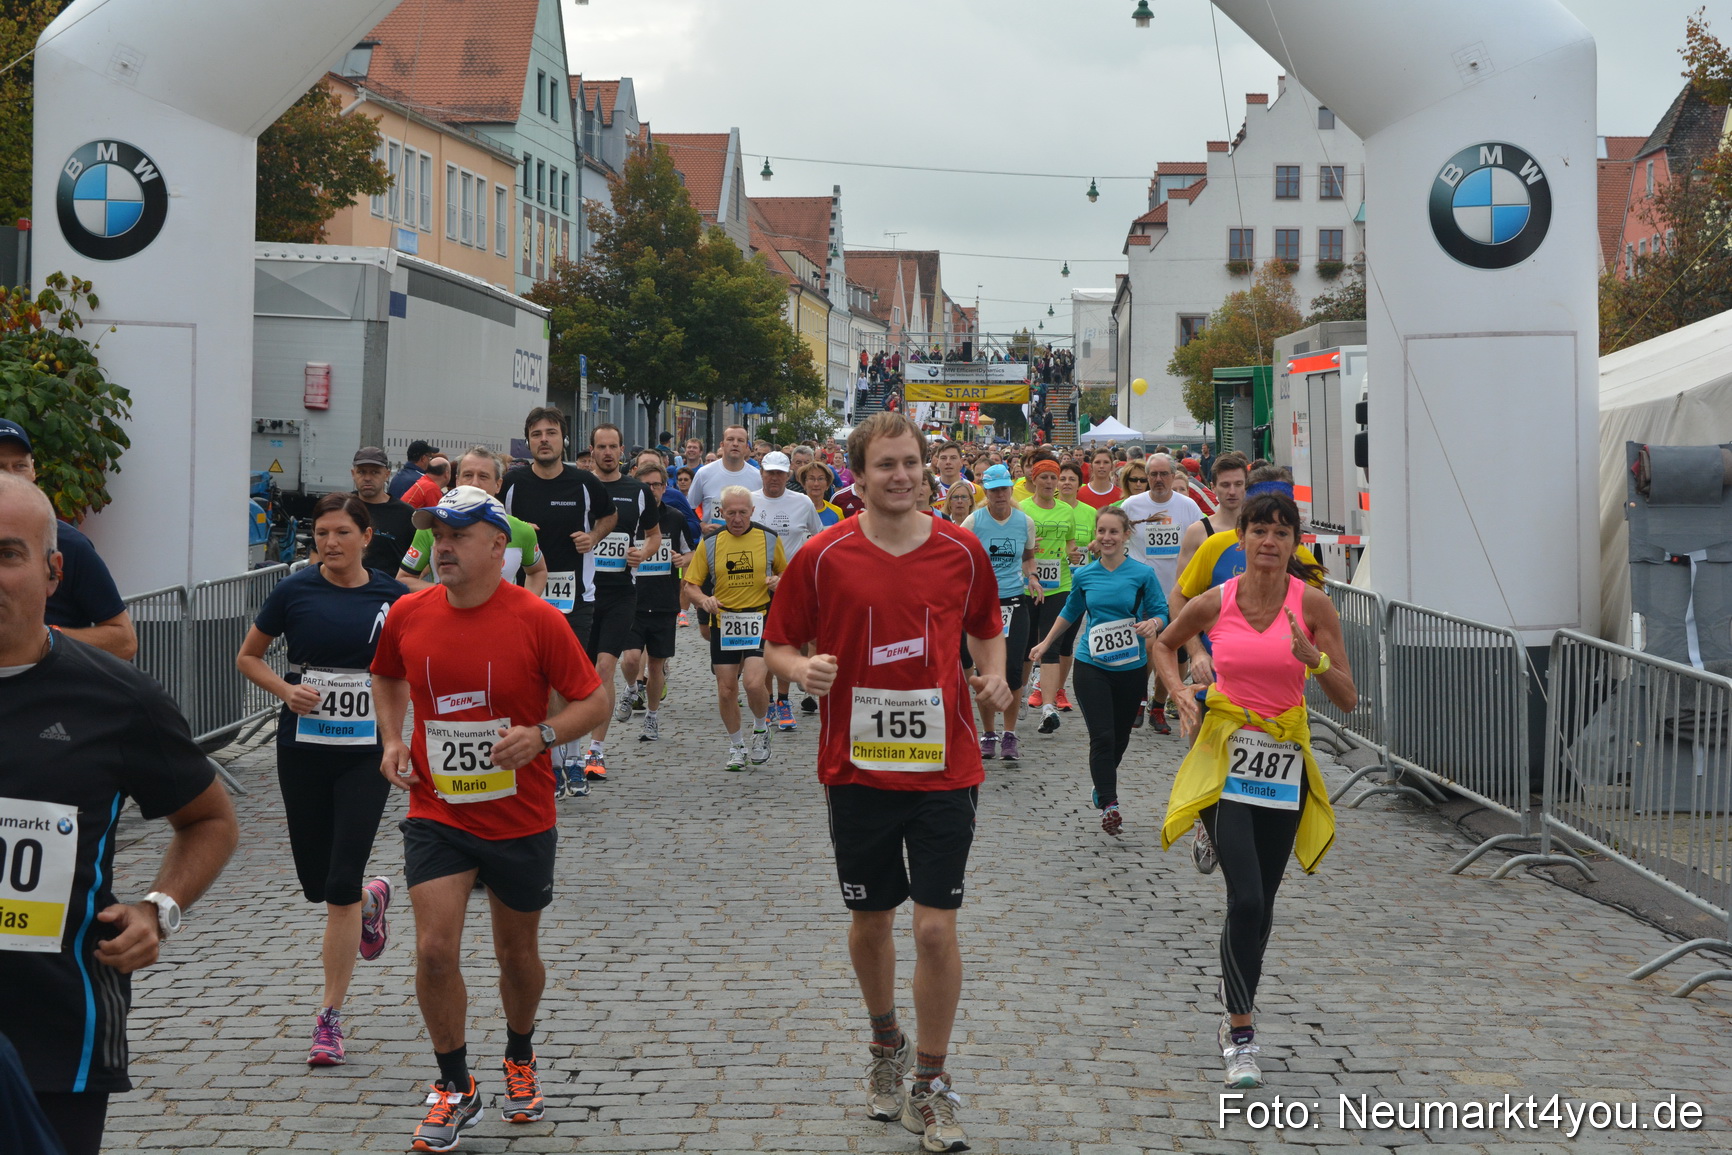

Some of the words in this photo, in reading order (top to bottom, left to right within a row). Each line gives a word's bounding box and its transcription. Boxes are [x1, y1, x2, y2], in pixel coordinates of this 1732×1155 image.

[64, 142, 159, 184] BMW
[1440, 145, 1543, 186] BMW
[513, 348, 542, 392] BOCK
[945, 387, 988, 398] START
[1148, 532, 1179, 546] 3329
[728, 573, 754, 581] HIRSCH
[725, 621, 759, 636] 2816
[1094, 629, 1134, 653] 2833
[886, 645, 911, 658] DEHN
[1103, 651, 1130, 662] Susanne
[302, 676, 326, 687] PARTL
[327, 680, 364, 688] Neumarkt
[309, 691, 370, 718] 490
[450, 696, 473, 708] DEHN
[854, 695, 883, 706] PARTL
[884, 698, 928, 707] Neumarkt
[318, 722, 355, 735] Verena
[871, 710, 927, 739] 155
[40, 732, 71, 741] adidas
[427, 728, 452, 738] PARTL
[453, 729, 496, 738] Neumarkt
[1228, 734, 1255, 746] PARTL
[1256, 740, 1292, 750] Neumarkt
[442, 741, 495, 771] 253
[852, 745, 905, 759] Christian
[909, 747, 943, 760] Xaver
[1230, 747, 1296, 780] 2487
[452, 779, 487, 792] Mario
[1241, 782, 1276, 797] Renate
[843, 882, 867, 900] 53
